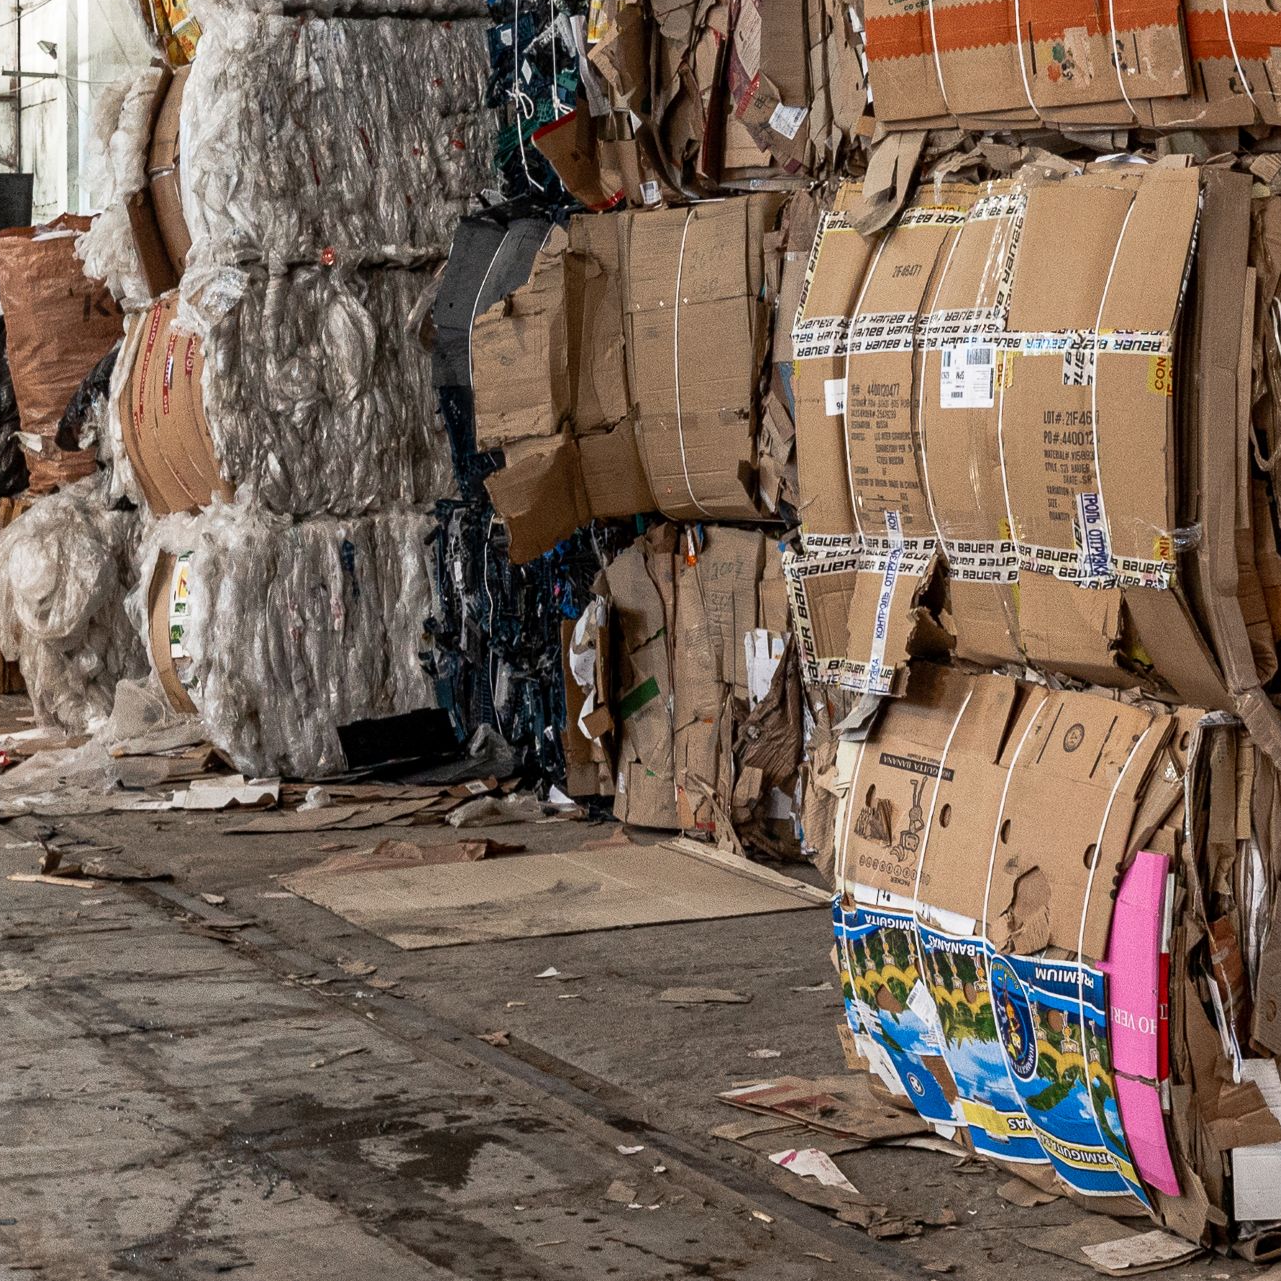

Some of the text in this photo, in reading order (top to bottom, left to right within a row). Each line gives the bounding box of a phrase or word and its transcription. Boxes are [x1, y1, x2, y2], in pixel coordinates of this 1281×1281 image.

[806, 535, 852, 548] BAUER
[957, 542, 995, 554] BAUER
[1036, 548, 1079, 564] BAUER
[874, 591, 891, 639] КОНТРОЛЬ
[864, 913, 918, 930] RMIGUITA
[927, 934, 977, 957] BANANAS
[1034, 966, 1095, 989] PREMIUM
